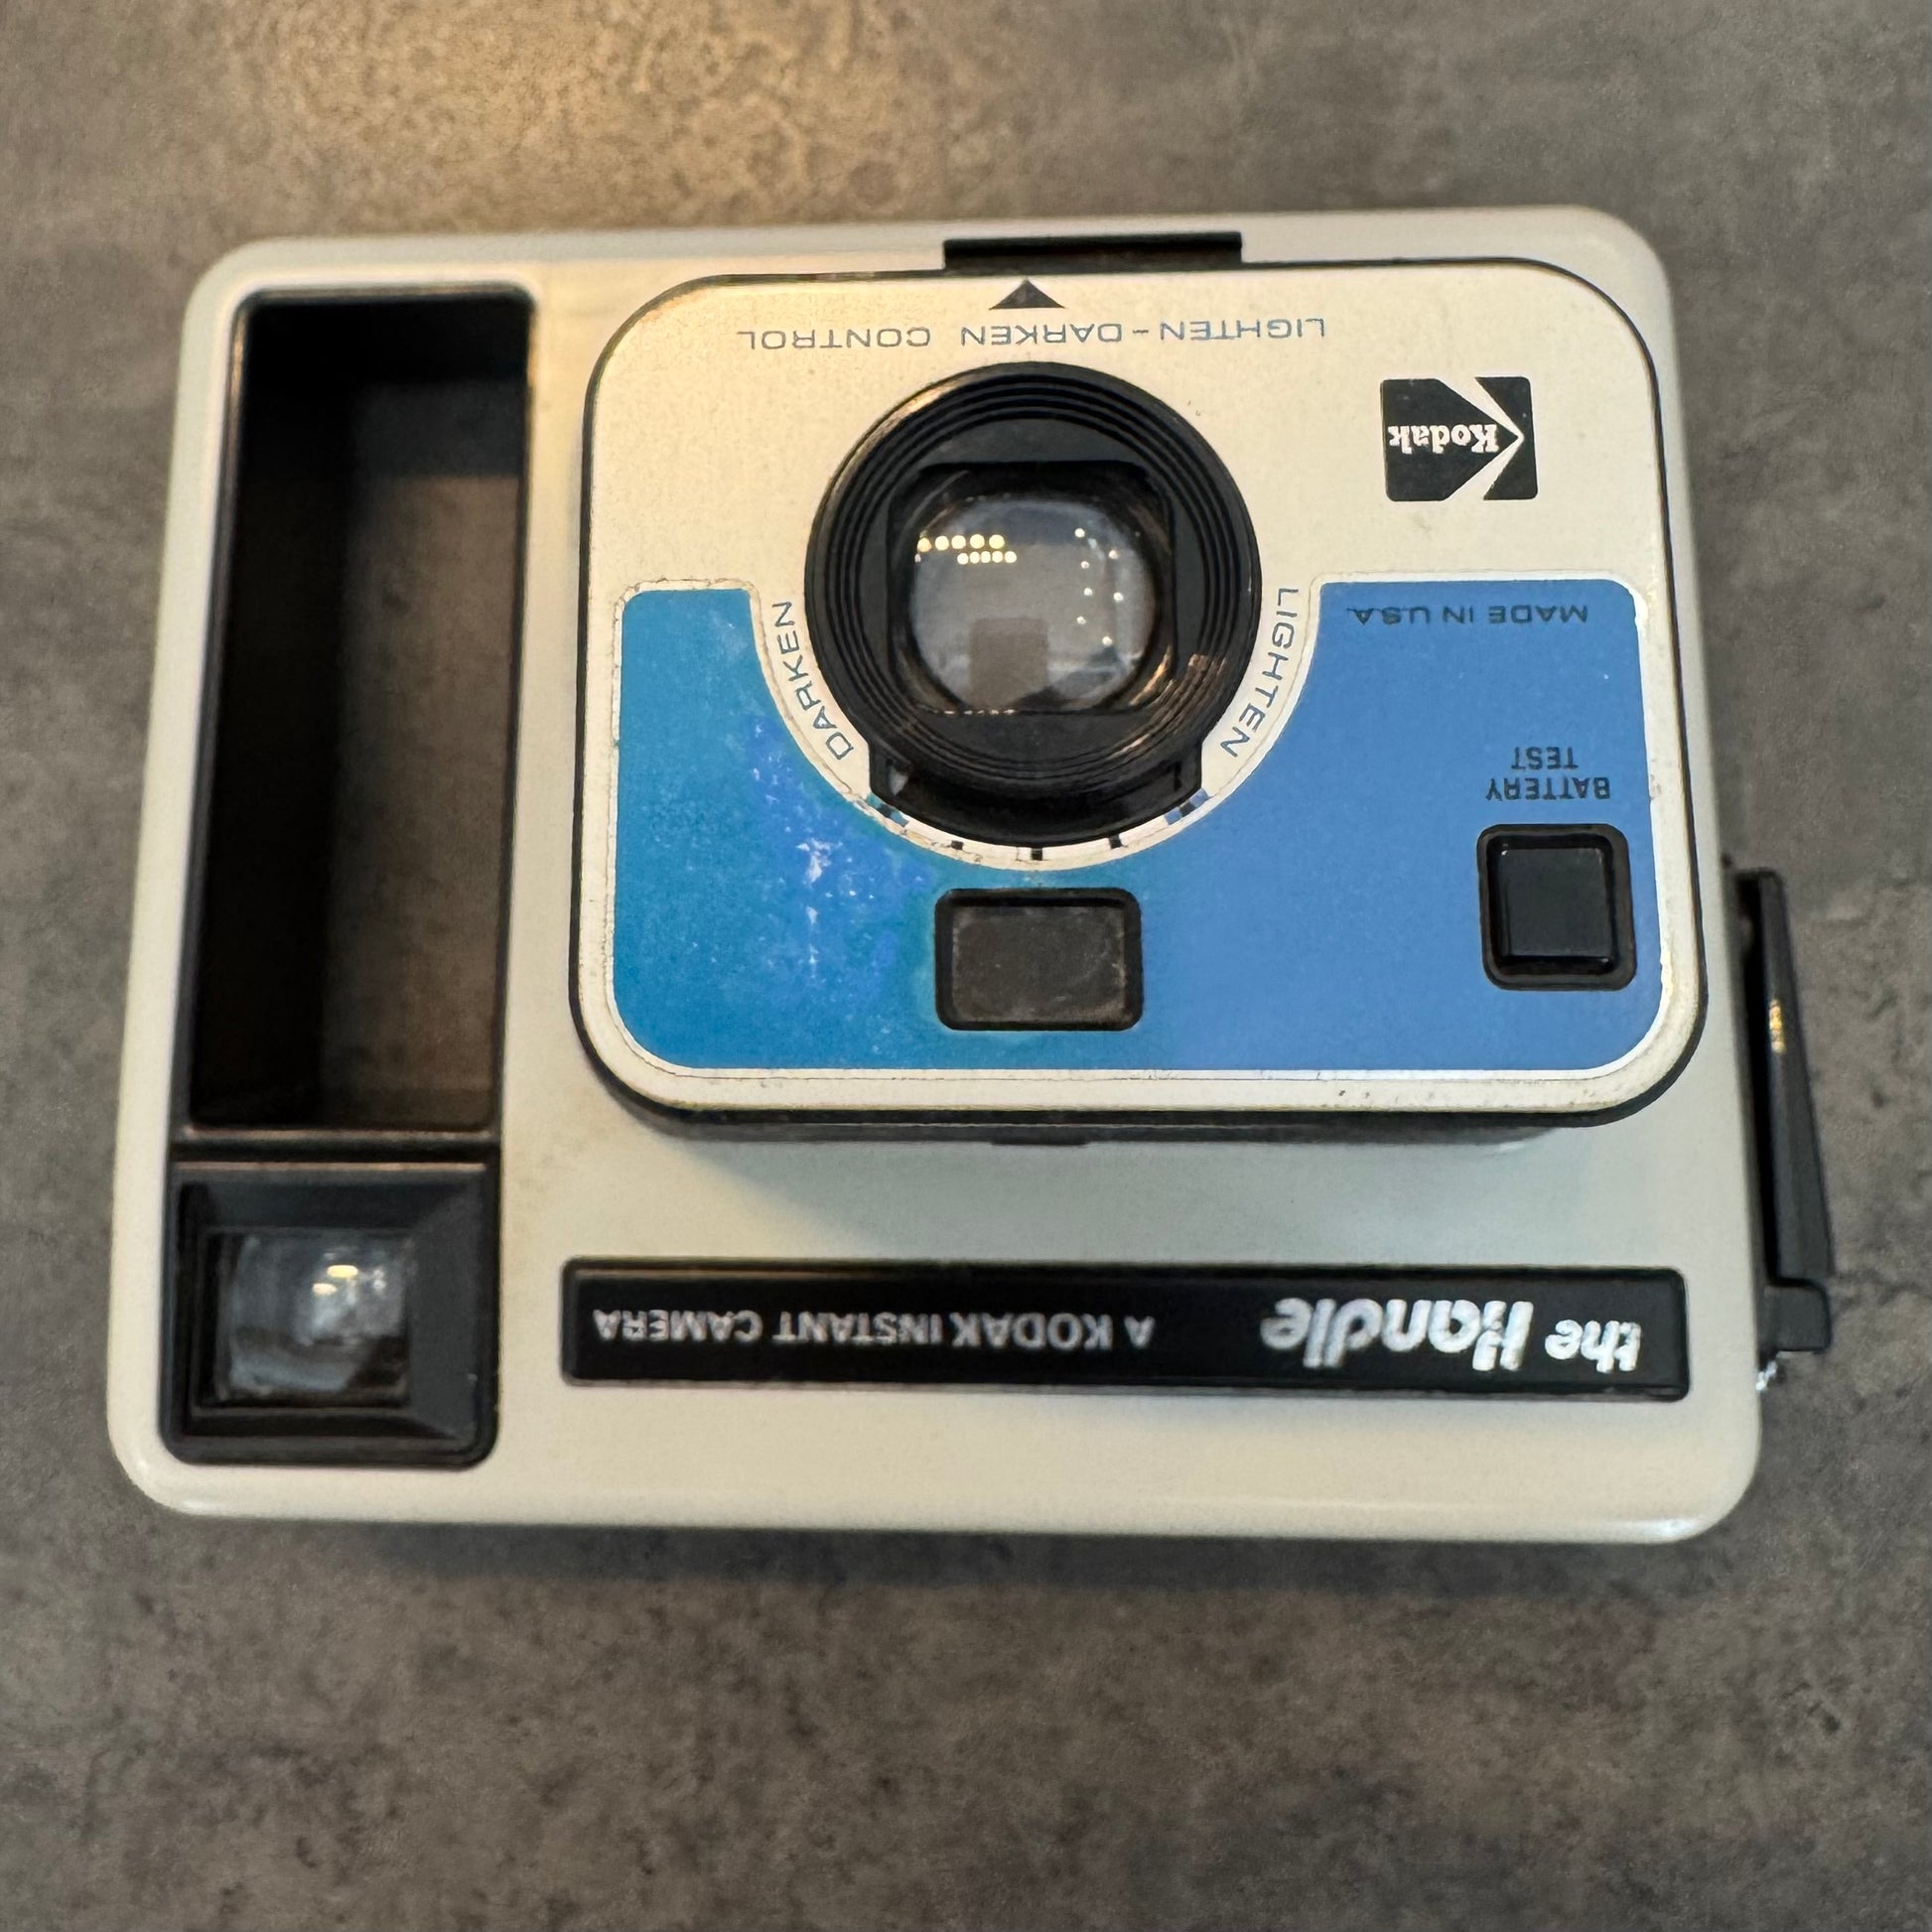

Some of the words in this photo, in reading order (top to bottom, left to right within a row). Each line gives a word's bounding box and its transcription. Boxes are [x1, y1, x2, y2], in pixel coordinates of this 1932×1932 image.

[737, 327, 930, 349] CONTROL
[960, 323, 1123, 345] DARKEN
[1160, 318, 1325, 342] LIGHTEN
[1388, 423, 1500, 454] Kodak
[1443, 605, 1474, 624] IN
[1489, 605, 1588, 624] MADE
[771, 601, 854, 760] DARKEN
[1220, 588, 1300, 758] LIGHTEN
[1511, 747, 1579, 769] TEST
[1485, 776, 1610, 801] BATTERY
[593, 1309, 763, 1342] CAMERA
[772, 1311, 942, 1345] INSTANT
[949, 1311, 1114, 1350] KODAK
[1123, 1314, 1156, 1349] A
[1259, 1298, 1535, 1372] Handle
[1544, 1318, 1642, 1373] the
